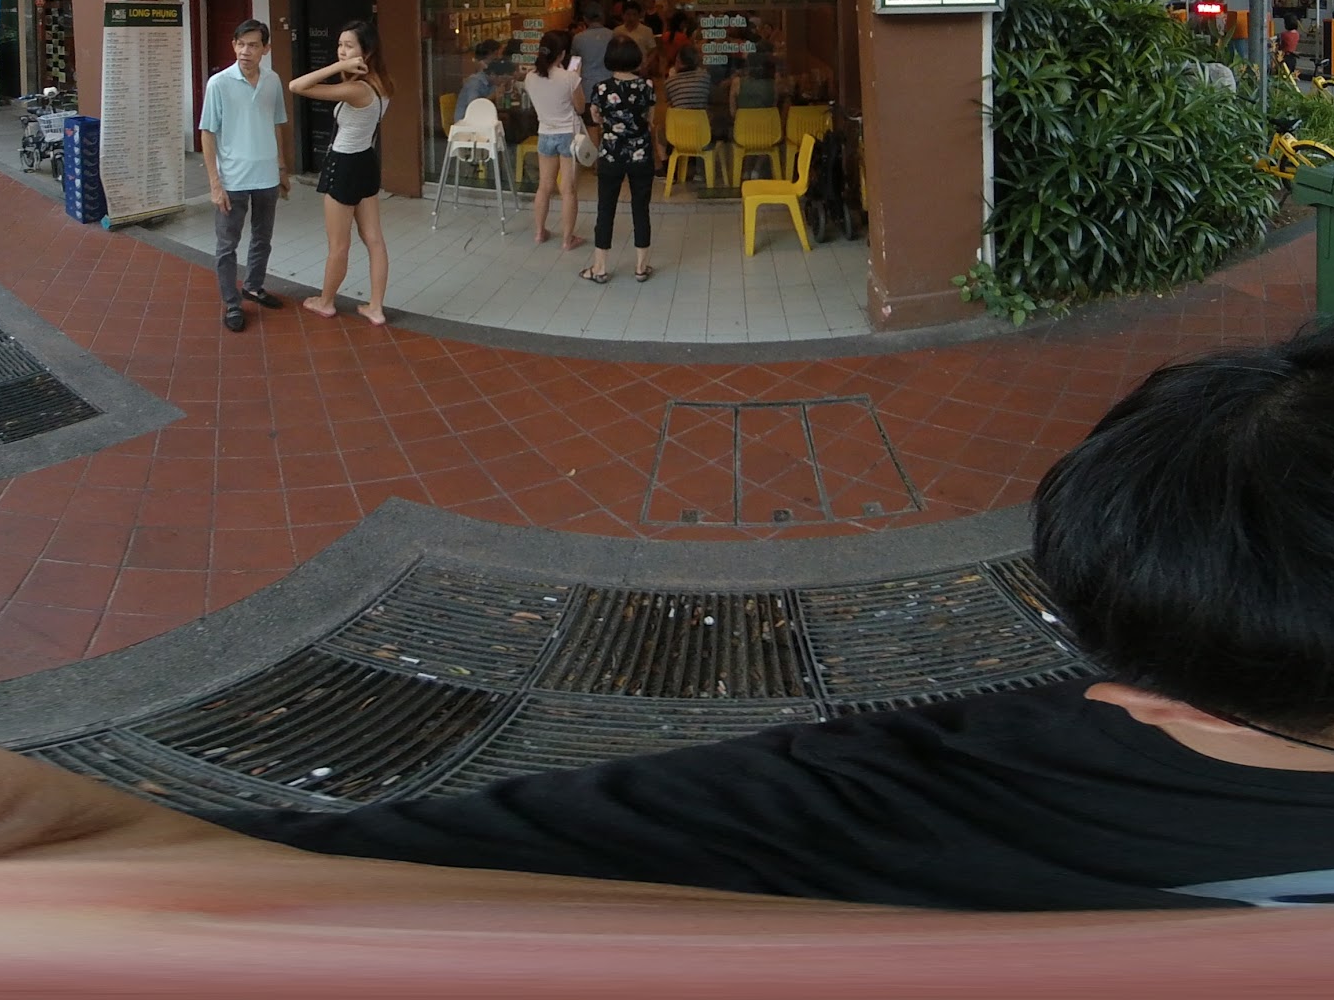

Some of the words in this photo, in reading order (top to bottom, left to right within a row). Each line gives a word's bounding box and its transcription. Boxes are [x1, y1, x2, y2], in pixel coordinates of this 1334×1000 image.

[129, 8, 151, 18] LONG
[151, 9, 178, 19] PHỤNG
[523, 19, 544, 29] OPEN
[702, 29, 727, 39] 12H00
[519, 43, 539, 52] CLOS
[702, 55, 728, 65] 23H00
